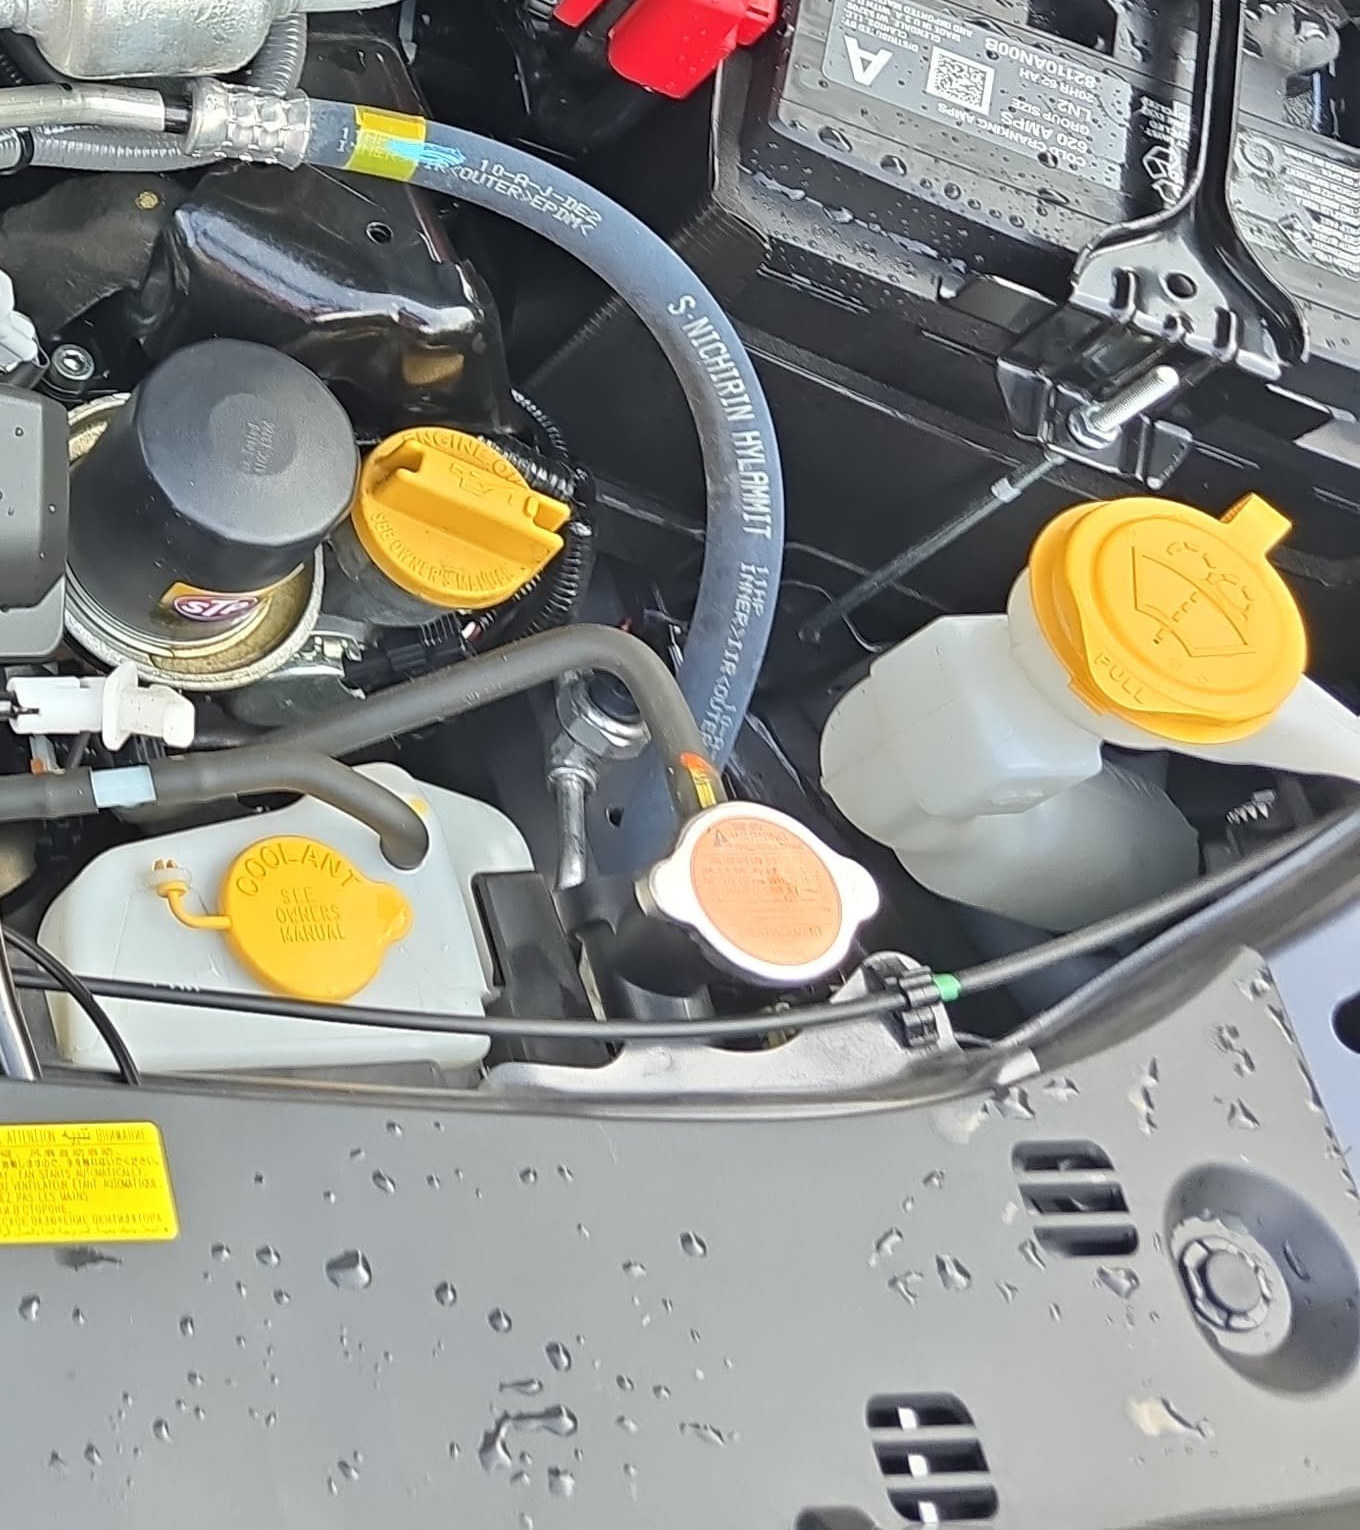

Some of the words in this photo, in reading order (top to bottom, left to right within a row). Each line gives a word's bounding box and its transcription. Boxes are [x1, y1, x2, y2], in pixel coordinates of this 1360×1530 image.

[866, 0, 890, 15] WITH
[904, 6, 952, 29] IMPORTED
[858, 24, 918, 52] DISTRIBUTED
[935, 27, 960, 42] MADE
[953, 24, 973, 38] AND
[844, 34, 893, 86] A
[985, 38, 1096, 89] 82110AN00B
[1019, 68, 1040, 83] AH
[1060, 83, 1094, 103] 20HR
[937, 102, 975, 123] AMPS
[1010, 97, 1041, 117] SIZE
[1057, 98, 1091, 122] LN2
[1000, 112, 1053, 140] AMPS
[1043, 112, 1090, 136] GROUP
[977, 118, 1047, 151] CRANKING
[1057, 133, 1088, 153] 620
[668, 295, 755, 421] S-NICHIRIN
[370, 512, 395, 542] SEE
[454, 564, 517, 592] MANUAL
[181, 598, 250, 618] STP
[235, 843, 361, 898] COOLANT
[280, 886, 315, 905] SEE
[275, 904, 342, 924] OWNERS
[279, 923, 347, 943] MANUAL
[6, 1130, 56, 1143] ATTENTION
